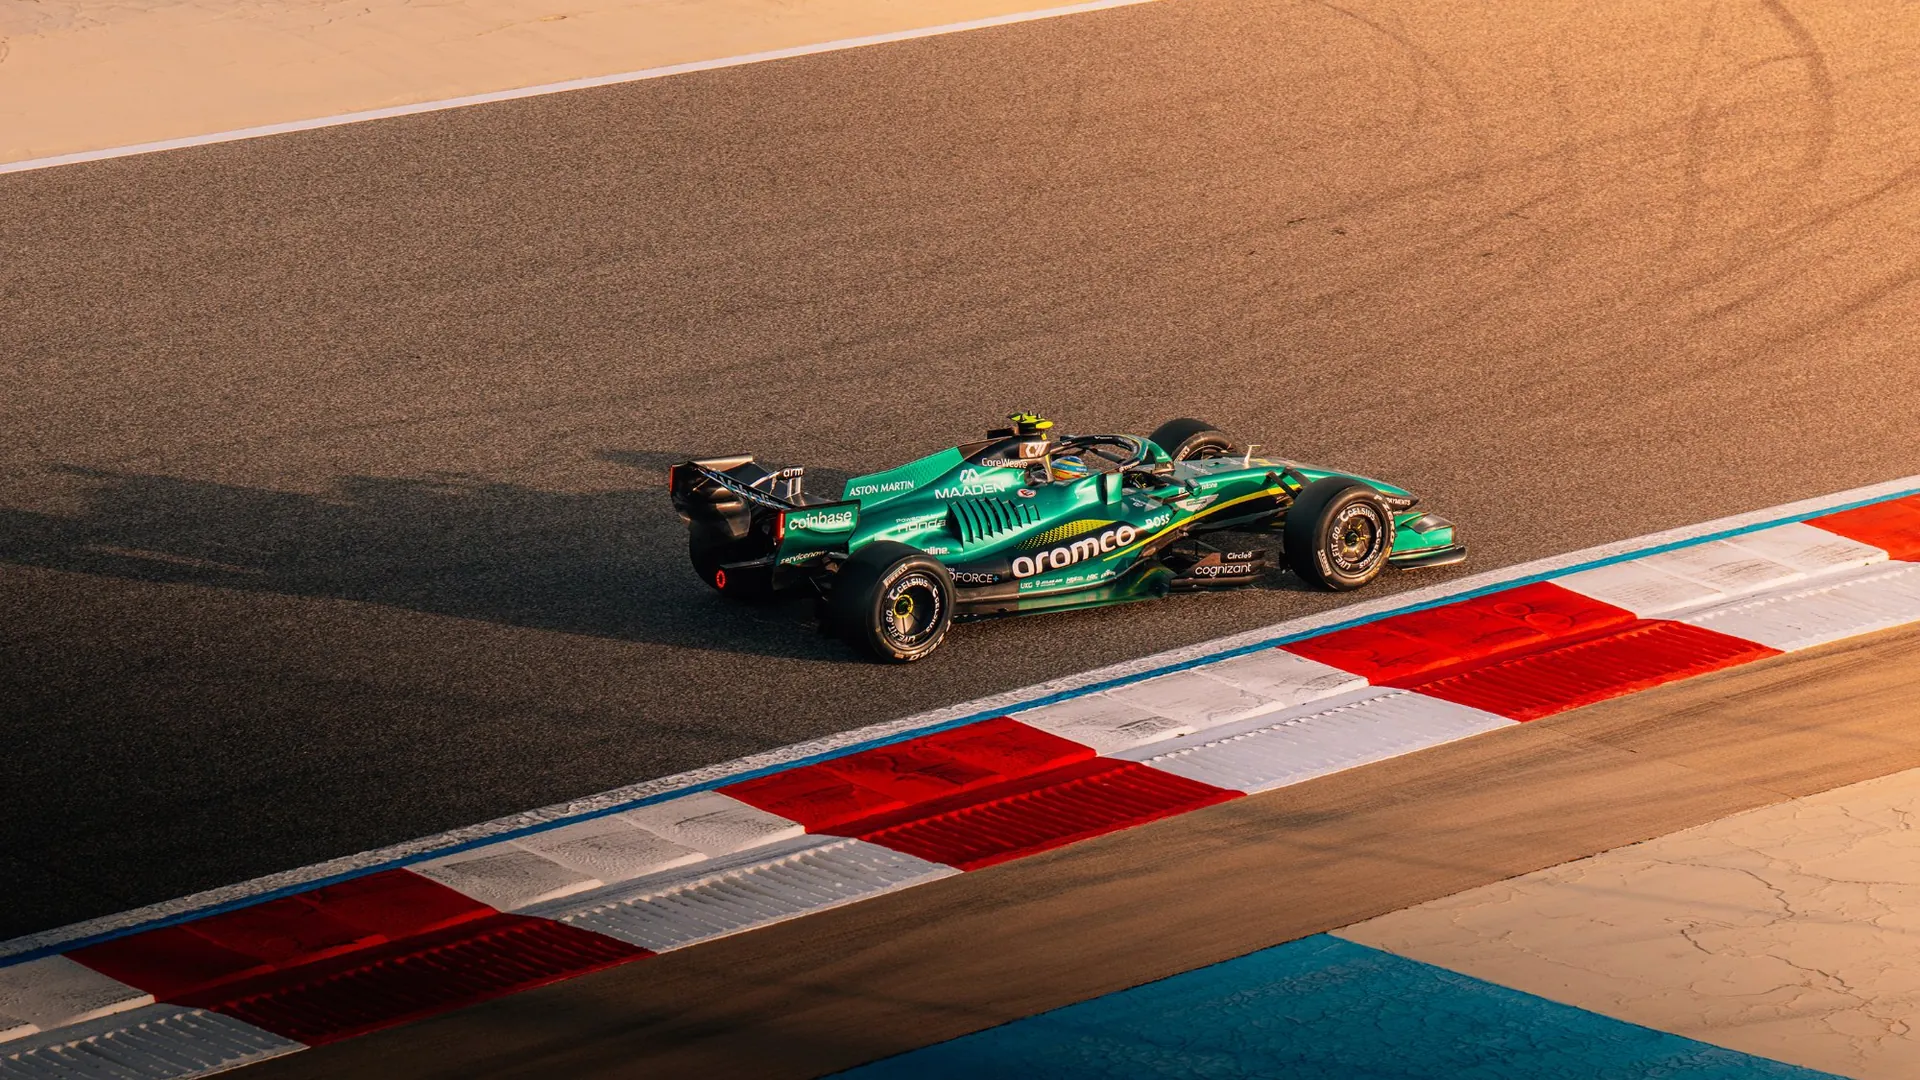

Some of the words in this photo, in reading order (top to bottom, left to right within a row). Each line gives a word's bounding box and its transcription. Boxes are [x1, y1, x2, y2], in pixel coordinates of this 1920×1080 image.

[982, 458, 1028, 468] CoreWeave
[783, 467, 803, 477] arm
[849, 485, 879, 496] ASTON
[880, 480, 914, 492] MARTIN
[934, 483, 1005, 499] MAADEN
[789, 511, 852, 530] coinbase
[1145, 514, 1170, 529] BOSS
[1348, 507, 1376, 521] CELSIUS
[1012, 525, 1136, 578] aramco
[1195, 562, 1252, 577] cognizant
[897, 578, 928, 593] CELSIUS
